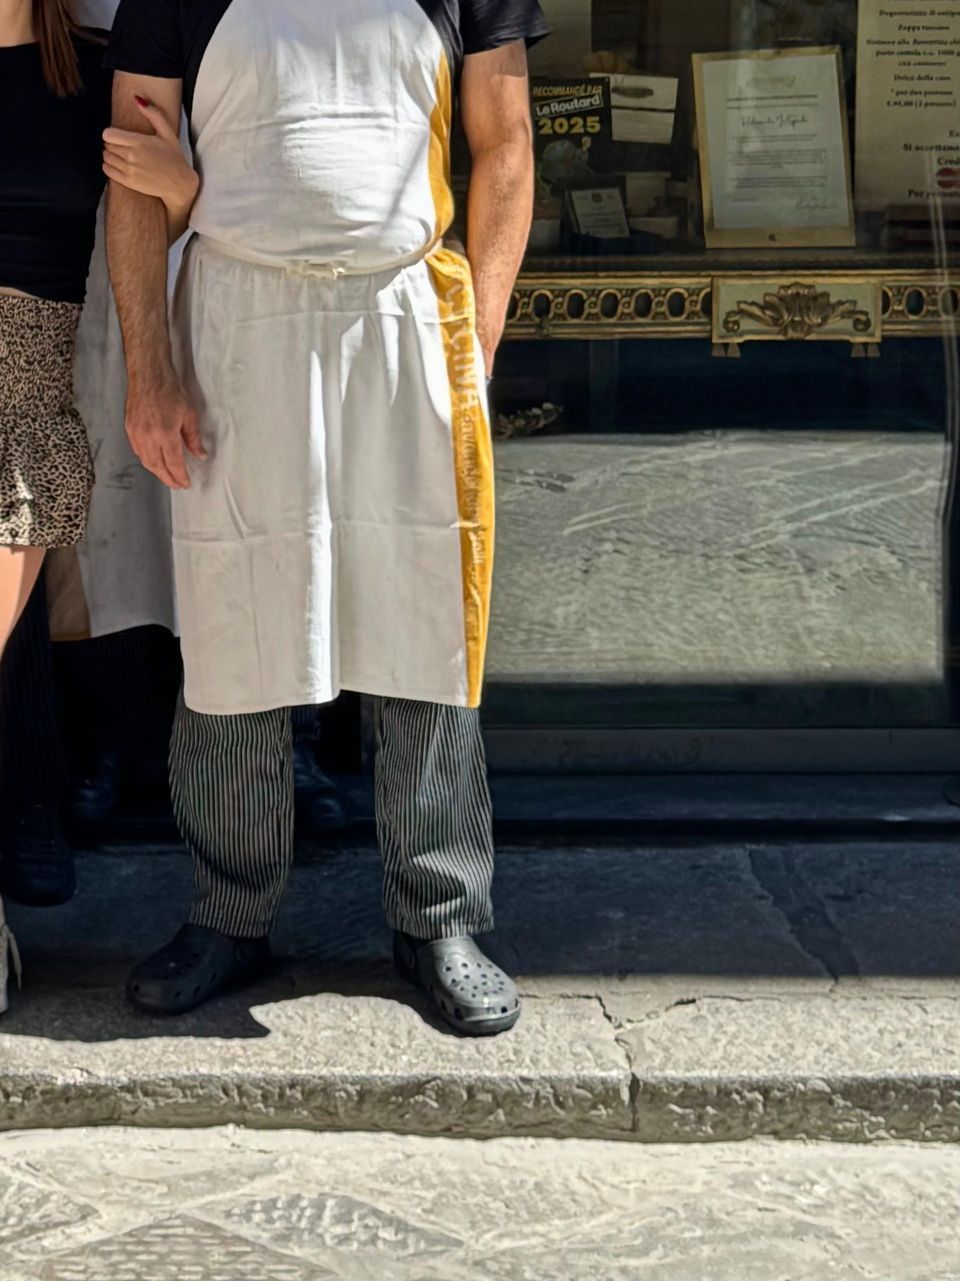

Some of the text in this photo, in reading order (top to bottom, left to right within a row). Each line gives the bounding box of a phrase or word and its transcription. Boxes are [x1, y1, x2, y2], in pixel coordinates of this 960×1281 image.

[536, 96, 600, 116] Le Routard
[538, 116, 601, 134] 2025
